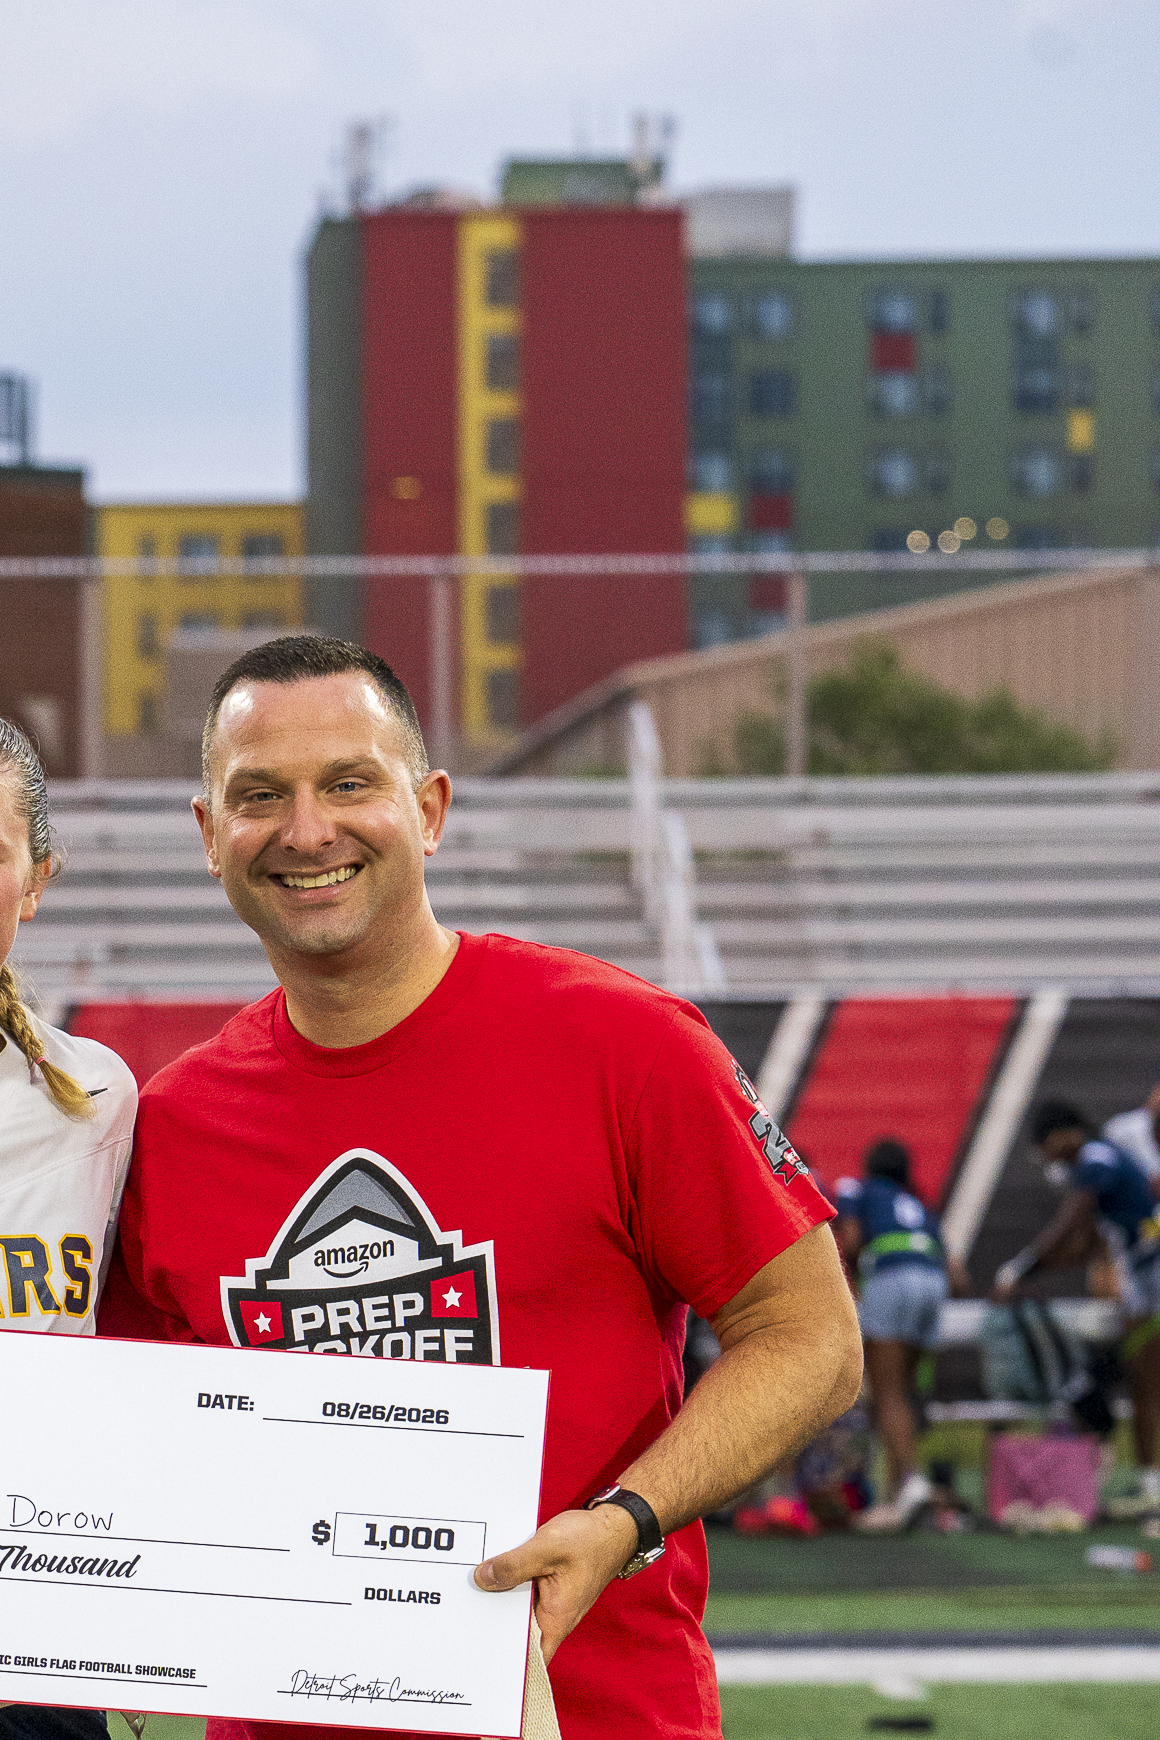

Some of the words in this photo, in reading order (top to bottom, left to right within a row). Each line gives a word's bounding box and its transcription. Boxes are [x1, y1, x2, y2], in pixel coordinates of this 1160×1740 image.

[313, 1239, 395, 1267] amazon
[290, 1292, 425, 1342] PREP
[287, 1328, 475, 1363] KOFF
[197, 1392, 255, 1412] DATE:
[321, 1401, 450, 1426] 08/26/2026
[6, 1494, 115, 1531] Dorow
[311, 1519, 332, 1546] $
[364, 1522, 455, 1552] 1,000
[363, 1586, 442, 1606] DOLLARS
[14, 1655, 48, 1669] GIRLS
[49, 1658, 77, 1671] FLAG
[78, 1660, 133, 1676] FOOTBALL
[134, 1664, 197, 1680] SHOWCASE
[291, 1669, 347, 1700] Detroit
[339, 1673, 390, 1704] Sports
[389, 1676, 465, 1704] Commission
